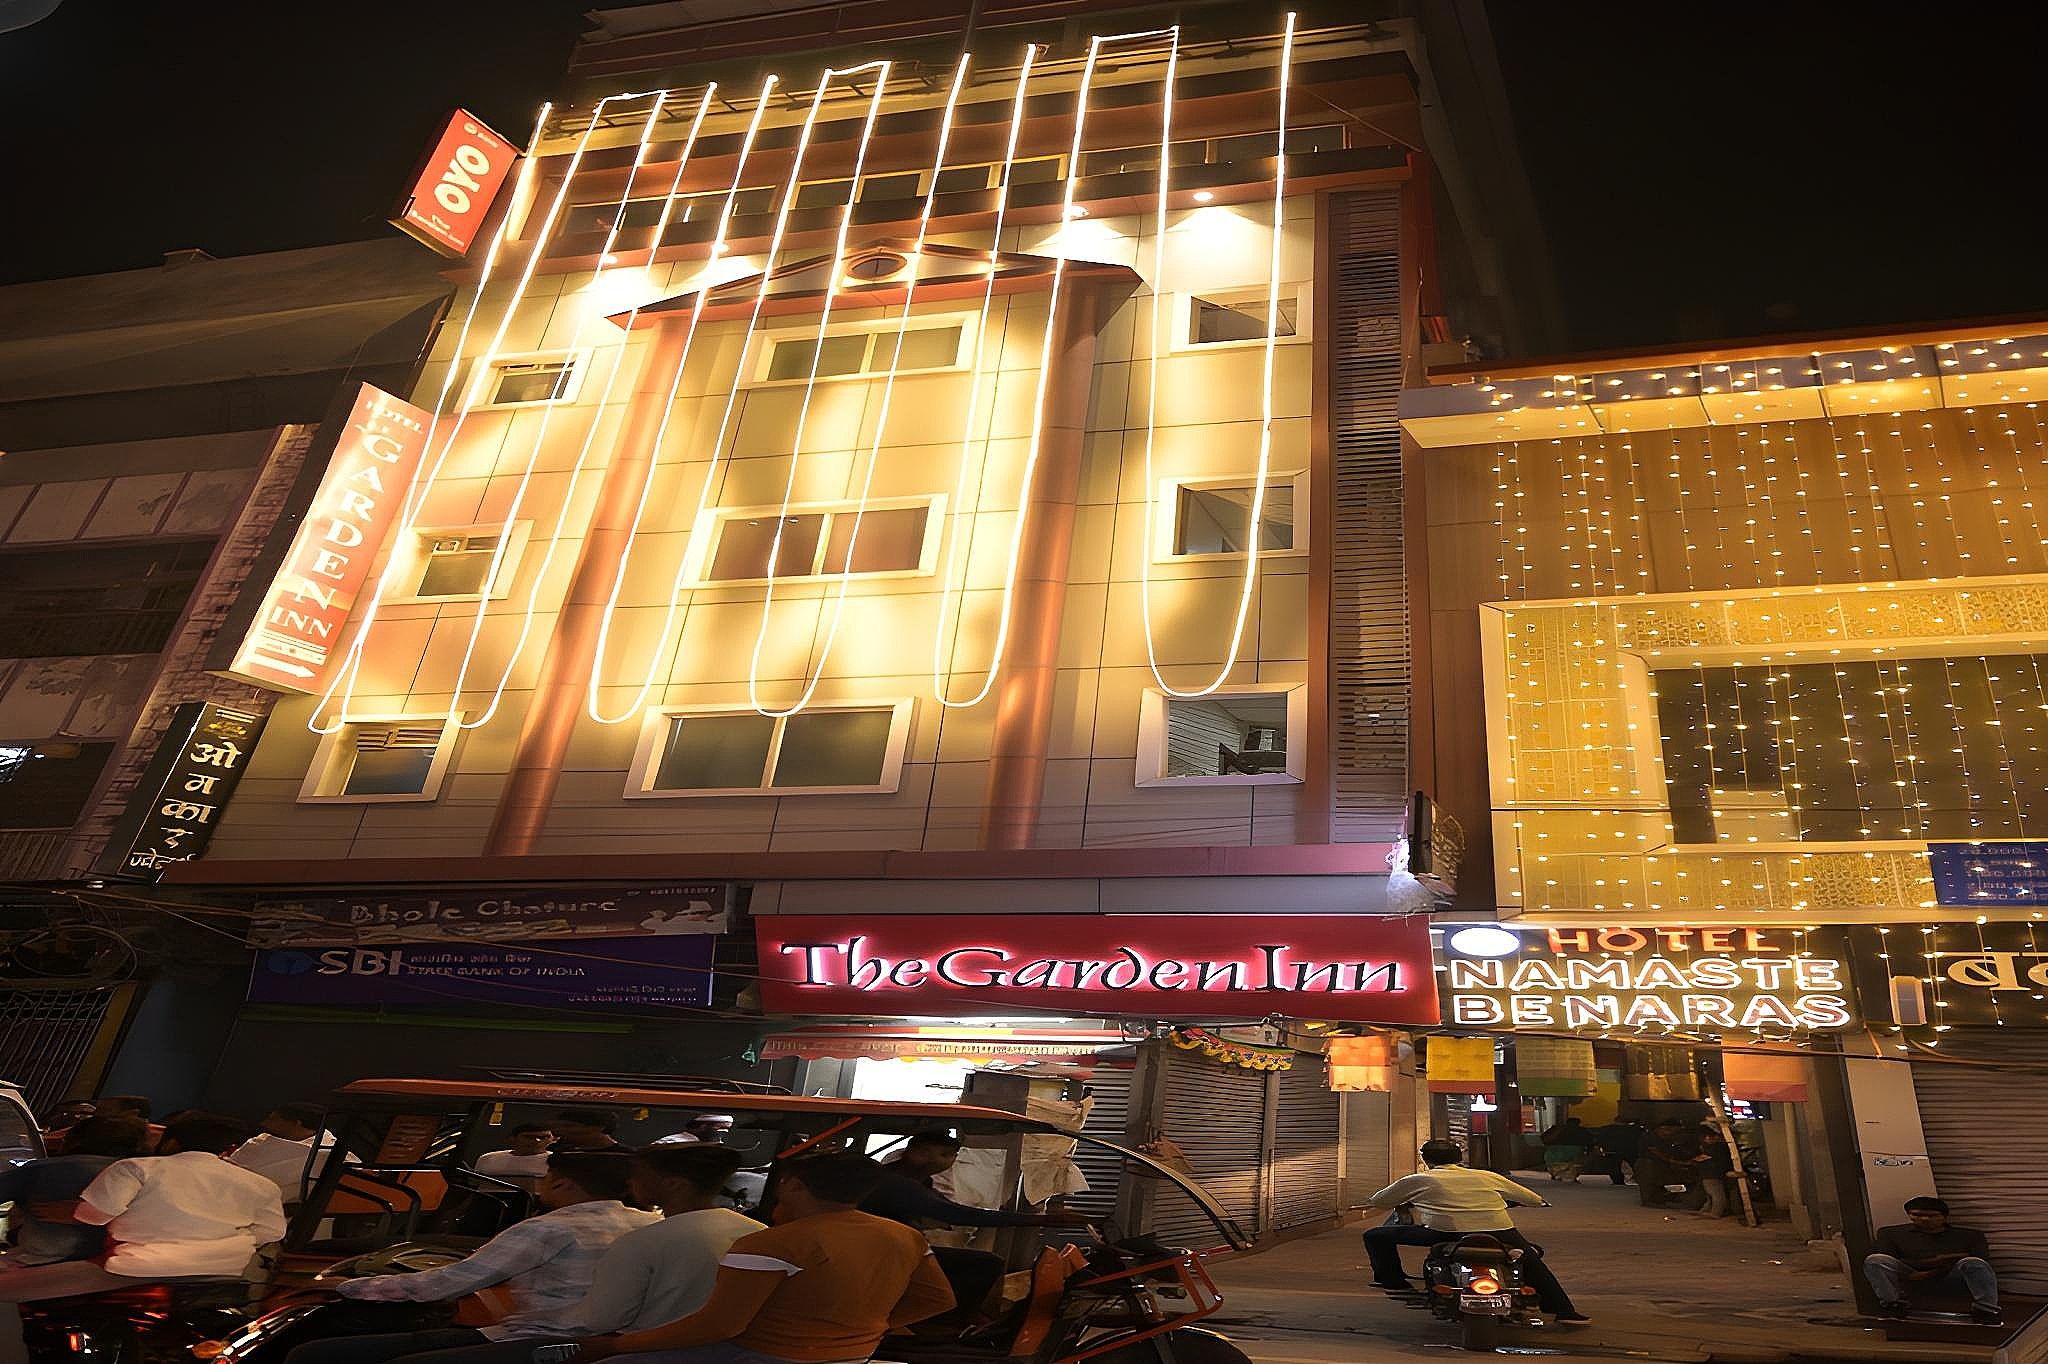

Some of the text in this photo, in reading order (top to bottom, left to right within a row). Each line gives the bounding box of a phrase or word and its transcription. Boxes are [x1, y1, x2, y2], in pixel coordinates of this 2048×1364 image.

[433, 143, 491, 214] OYO
[294, 433, 404, 611] GARDEN
[268, 606, 333, 640] INN
[1548, 927, 1780, 953] HOTEL
[316, 949, 403, 977] SBI
[1450, 958, 1843, 991] NAMASTE
[1452, 994, 1851, 1028] BENARAS
